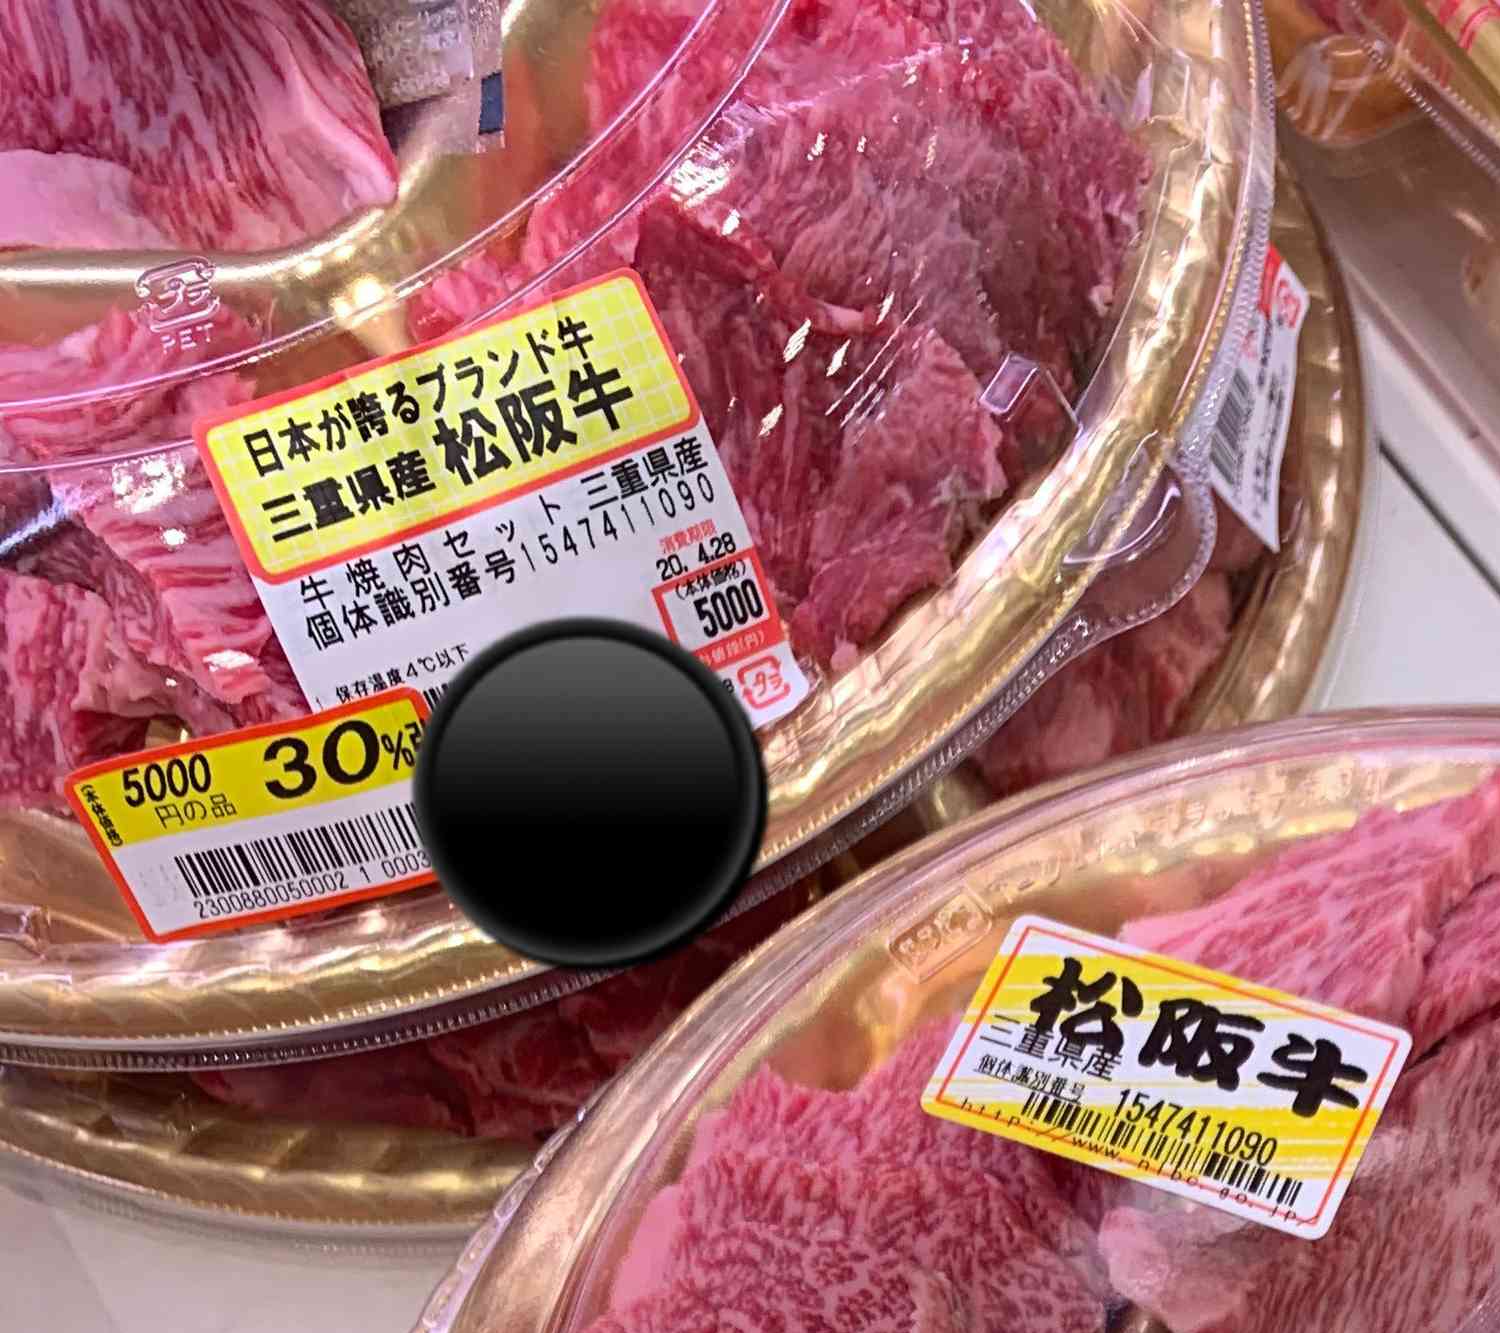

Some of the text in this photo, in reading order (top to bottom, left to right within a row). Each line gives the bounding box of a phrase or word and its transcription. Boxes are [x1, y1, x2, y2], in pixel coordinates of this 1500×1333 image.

[161, 323, 214, 355] PET
[244, 316, 595, 477] 日本が誇るブランド牛
[262, 361, 634, 543] 三重県産 松阪牛
[580, 436, 708, 512] 三重県産
[659, 518, 717, 554] 消費期限
[693, 579, 764, 638] 5000
[122, 753, 211, 807] 5000
[153, 793, 238, 830] 円の品
[193, 871, 349, 920] 2300880050002
[979, 1014, 1123, 1082] 三重県産
[1030, 956, 1369, 1119] 松阪牛
[974, 1053, 1088, 1101] 個体識別番号
[1114, 1088, 1279, 1167] 1547411090
